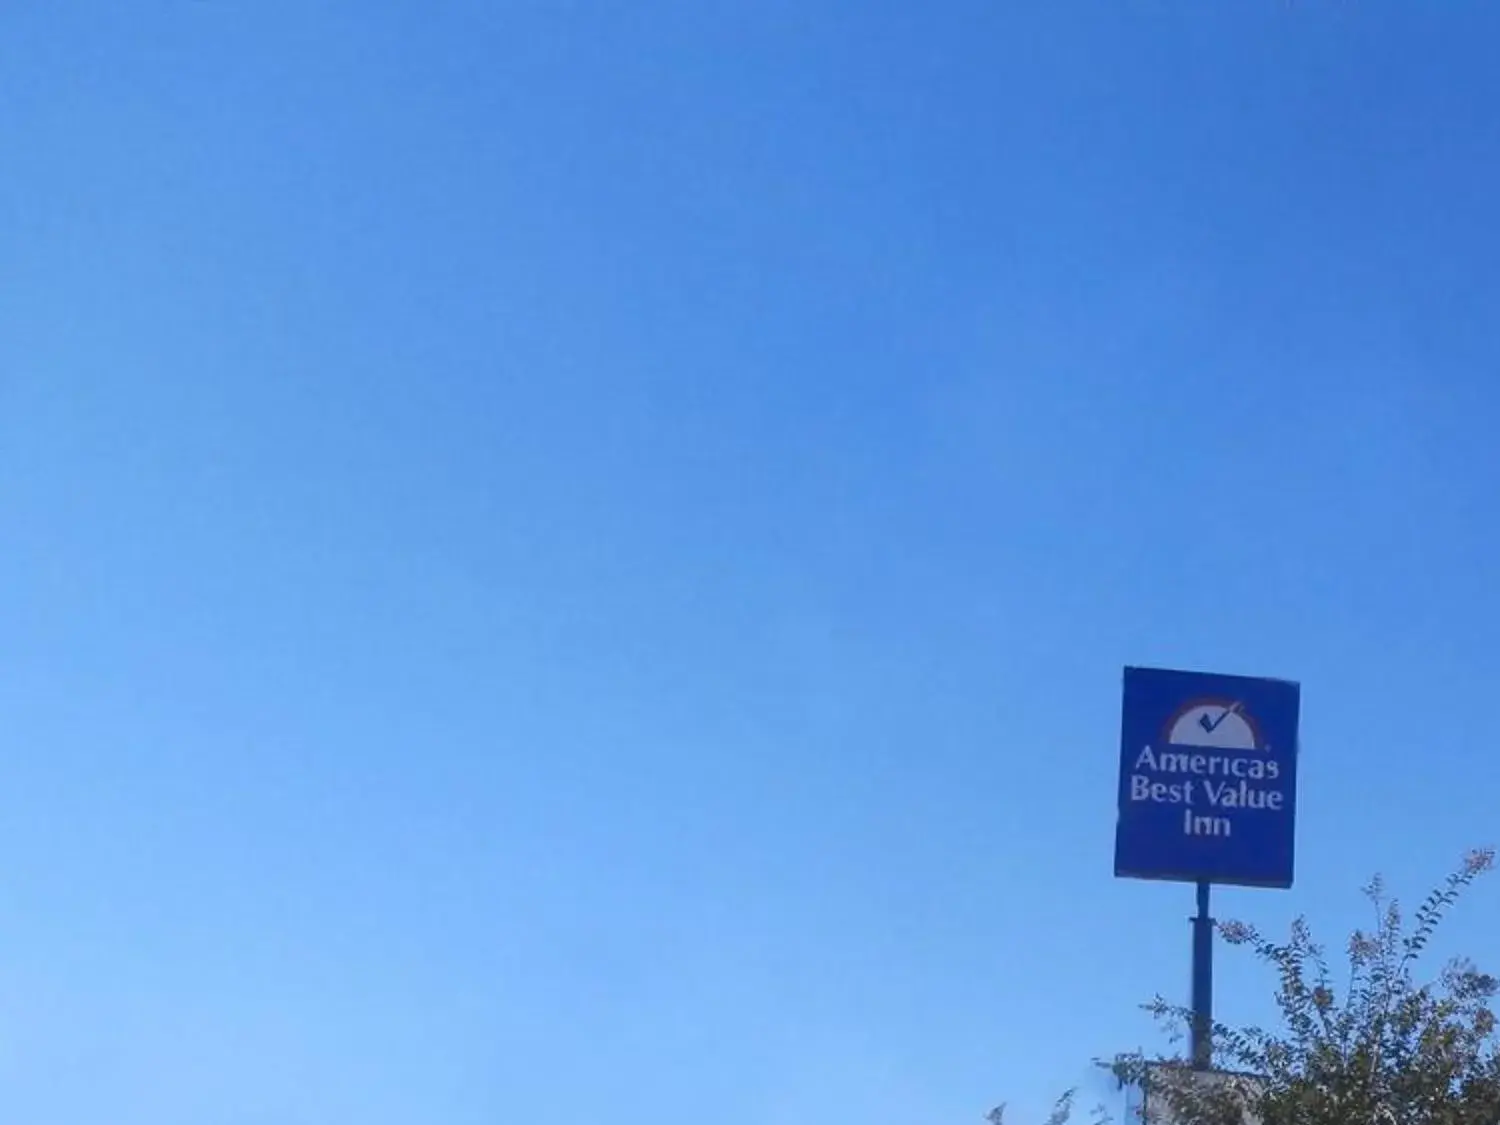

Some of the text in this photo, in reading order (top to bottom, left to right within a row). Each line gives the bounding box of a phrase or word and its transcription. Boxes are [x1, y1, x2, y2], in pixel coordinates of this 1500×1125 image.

[1135, 745, 1279, 779] Americas
[1131, 775, 1283, 810] Best Value
[1184, 809, 1231, 837] Inn
